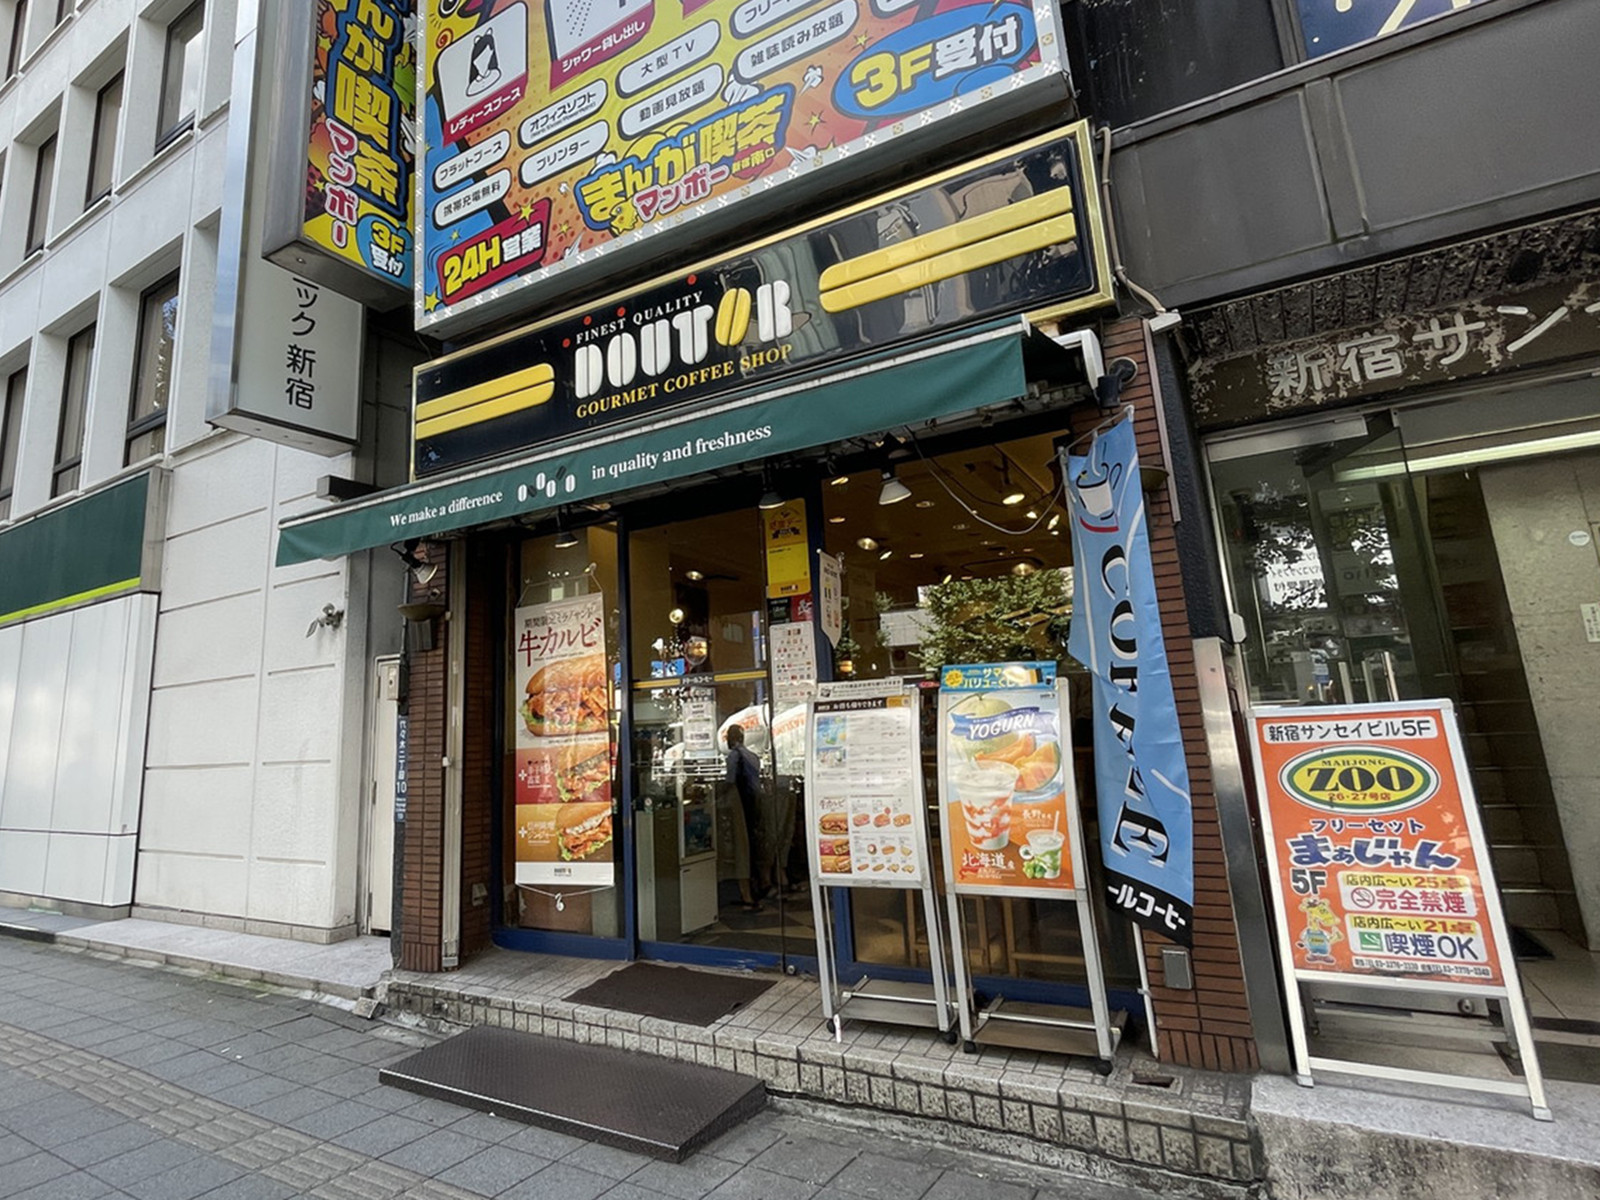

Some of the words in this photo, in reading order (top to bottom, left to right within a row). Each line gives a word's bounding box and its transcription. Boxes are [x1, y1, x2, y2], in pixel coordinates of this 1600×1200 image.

[562, 20, 646, 72] シャワー貸し出し
[750, 11, 845, 67] 雑誌読み放題
[851, 16, 1019, 108] 3F受付
[529, 92, 597, 133] オフィスソフト
[638, 79, 706, 123] 動画見放題
[536, 139, 591, 172] プリンター
[580, 93, 786, 223] まんが喫茶
[327, 119, 358, 246] マンボー
[442, 181, 502, 219] 携帯充電無料
[635, 165, 728, 220] マンボー
[371, 220, 405, 254] 3F
[369, 243, 404, 277] 受付
[443, 222, 543, 297] 24H営業
[574, 279, 793, 400] DOUTOR
[576, 317, 627, 345] FINEST
[632, 291, 703, 326] QUALITY
[285, 277, 320, 410] ック新宿
[575, 383, 659, 419] GOURMET
[663, 360, 735, 394] COFFEE
[740, 344, 793, 371] SHOP
[390, 514, 407, 527] We
[408, 507, 438, 524] make
[439, 505, 447, 516] a
[448, 491, 503, 514] difference
[592, 465, 606, 480] in
[609, 451, 660, 478] quality
[662, 443, 692, 464] and
[696, 424, 772, 455] freshness
[517, 617, 602, 668] 牛カルビ
[968, 712, 1036, 740] YOGURN
[1268, 719, 1432, 742] 新宿サンセイビル5F
[1306, 765, 1415, 792] ZOO
[1321, 758, 1387, 768] MAHJONG
[1310, 818, 1425, 834] フリーセット
[1291, 868, 1327, 895] 5F
[1376, 888, 1468, 914] 完全禁煙
[1384, 932, 1479, 960] 喫煙OK
